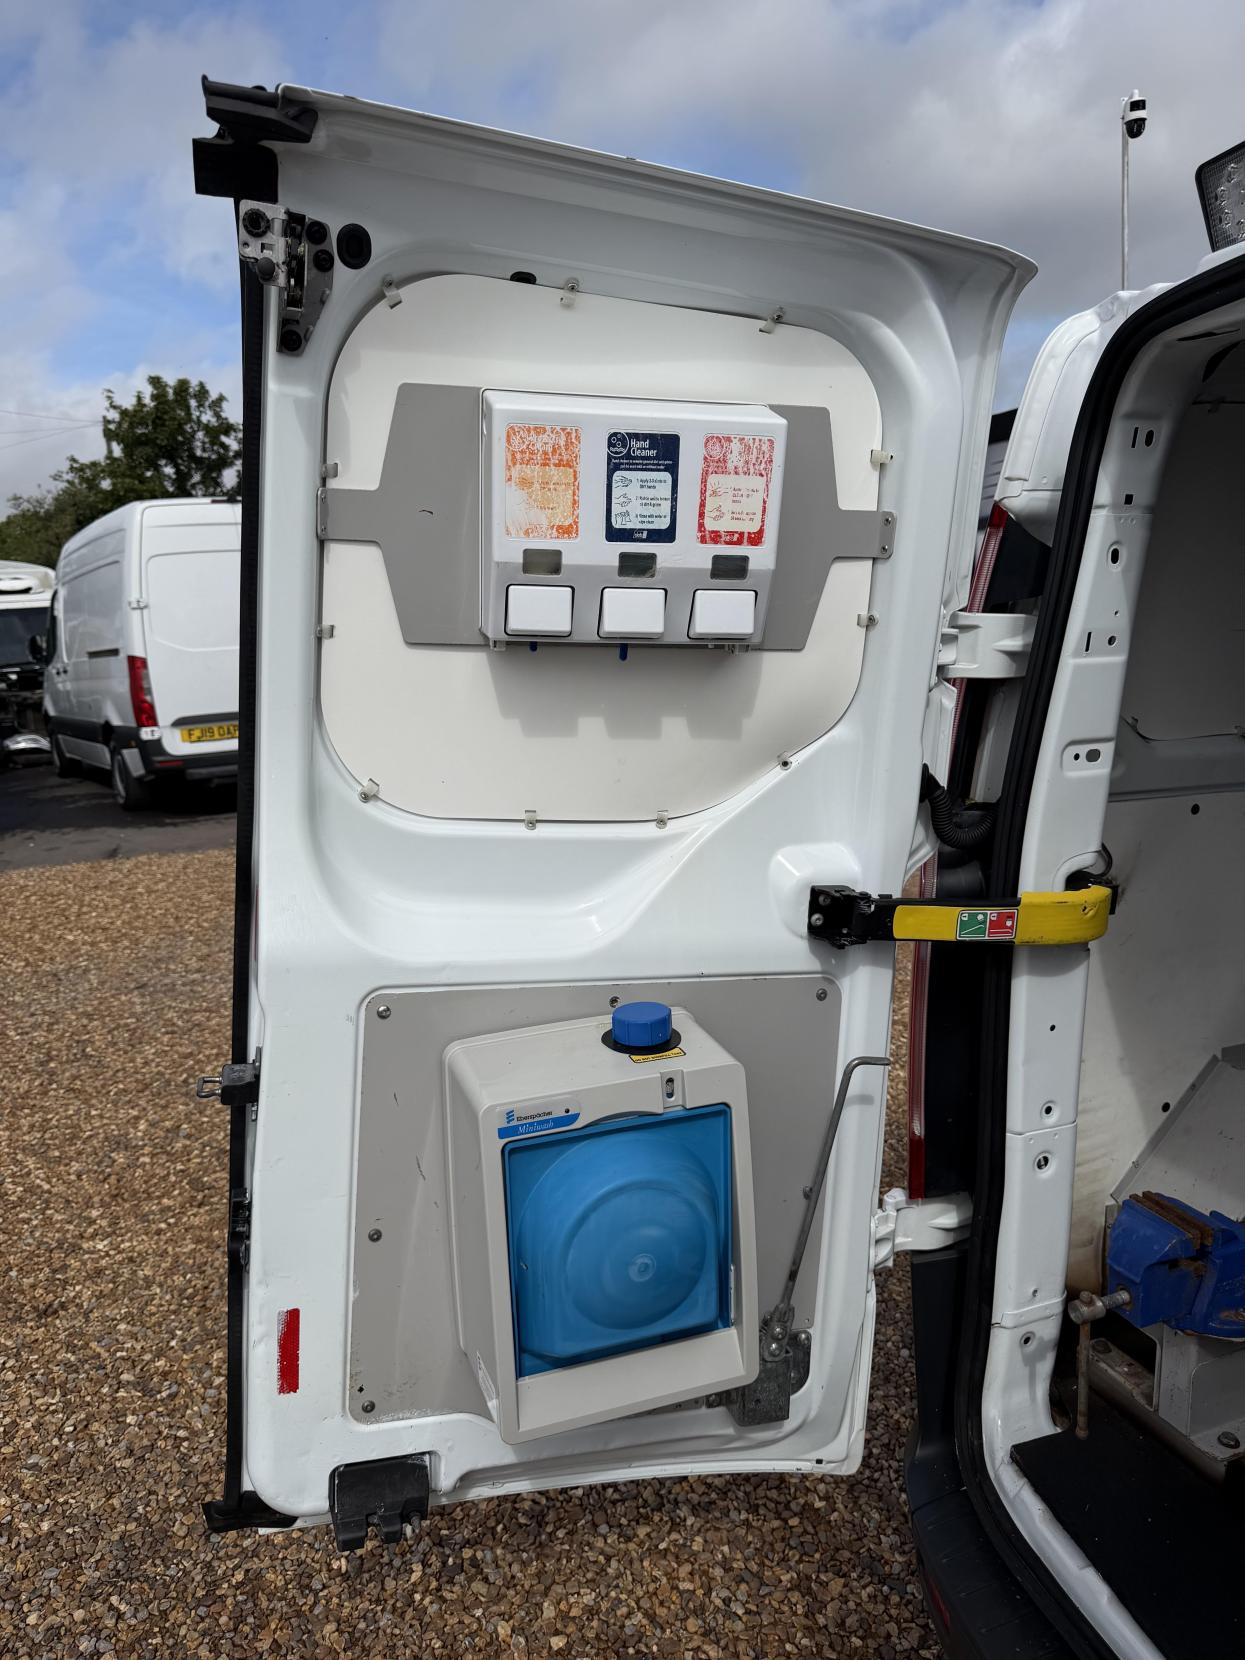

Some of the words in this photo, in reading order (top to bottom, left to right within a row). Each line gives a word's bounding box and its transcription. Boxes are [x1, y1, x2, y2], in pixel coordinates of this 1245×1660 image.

[630, 439, 649, 448] Hand
[630, 447, 657, 456] Cleaner
[188, 726, 214, 739] FJ19
[518, 1120, 554, 1133] Miniwash
